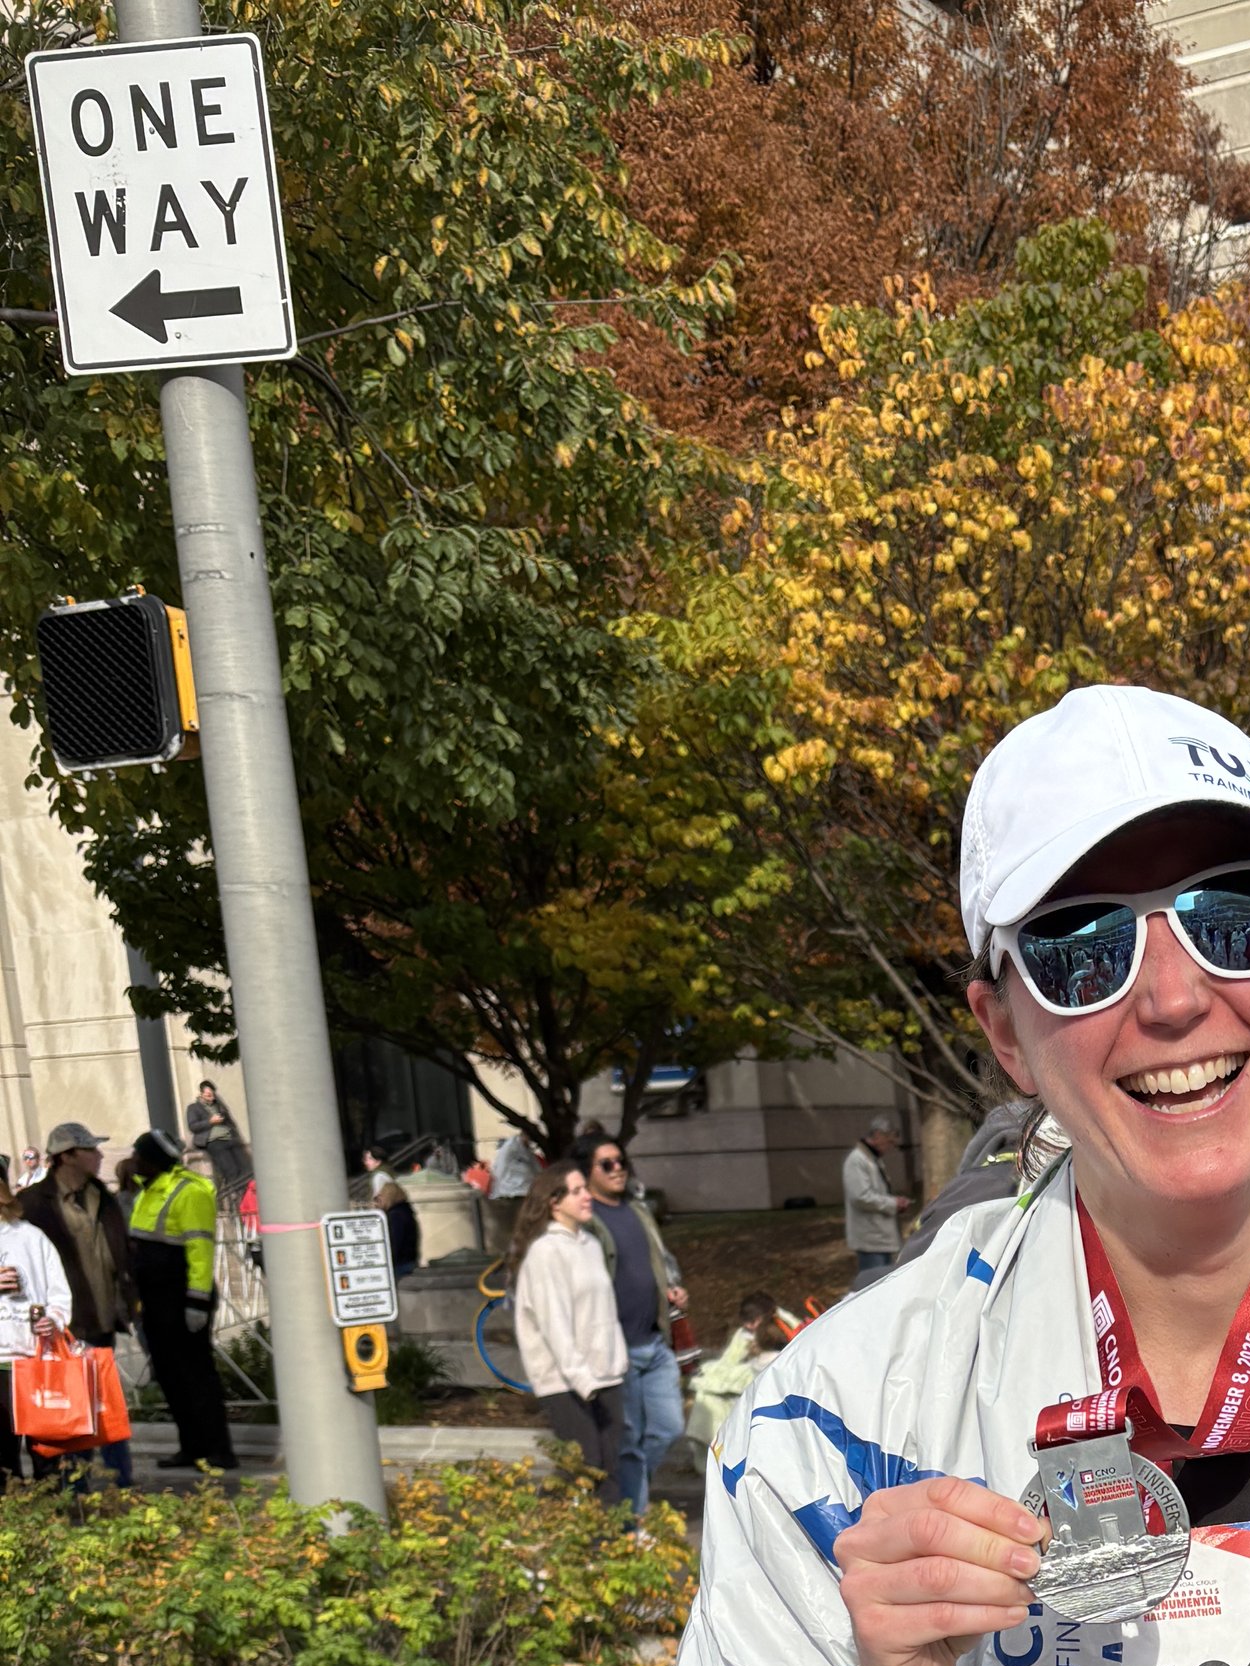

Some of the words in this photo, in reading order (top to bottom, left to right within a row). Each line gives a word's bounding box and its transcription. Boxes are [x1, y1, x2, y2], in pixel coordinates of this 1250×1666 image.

[70, 76, 236, 158] ONE
[73, 176, 250, 257] WAY
[1104, 1334, 1123, 1387] CNO
[1200, 1386, 1246, 1450] NOVEMBER
[1094, 1466, 1116, 1478] CNO
[1138, 1464, 1181, 1521] FINISHER
[1023, 1492, 1041, 1514] 25
[1143, 1611, 1168, 1622] HALF
[1168, 1606, 1222, 1621] MARATHON
[1154, 1595, 1221, 1611] ONUMENTAL
